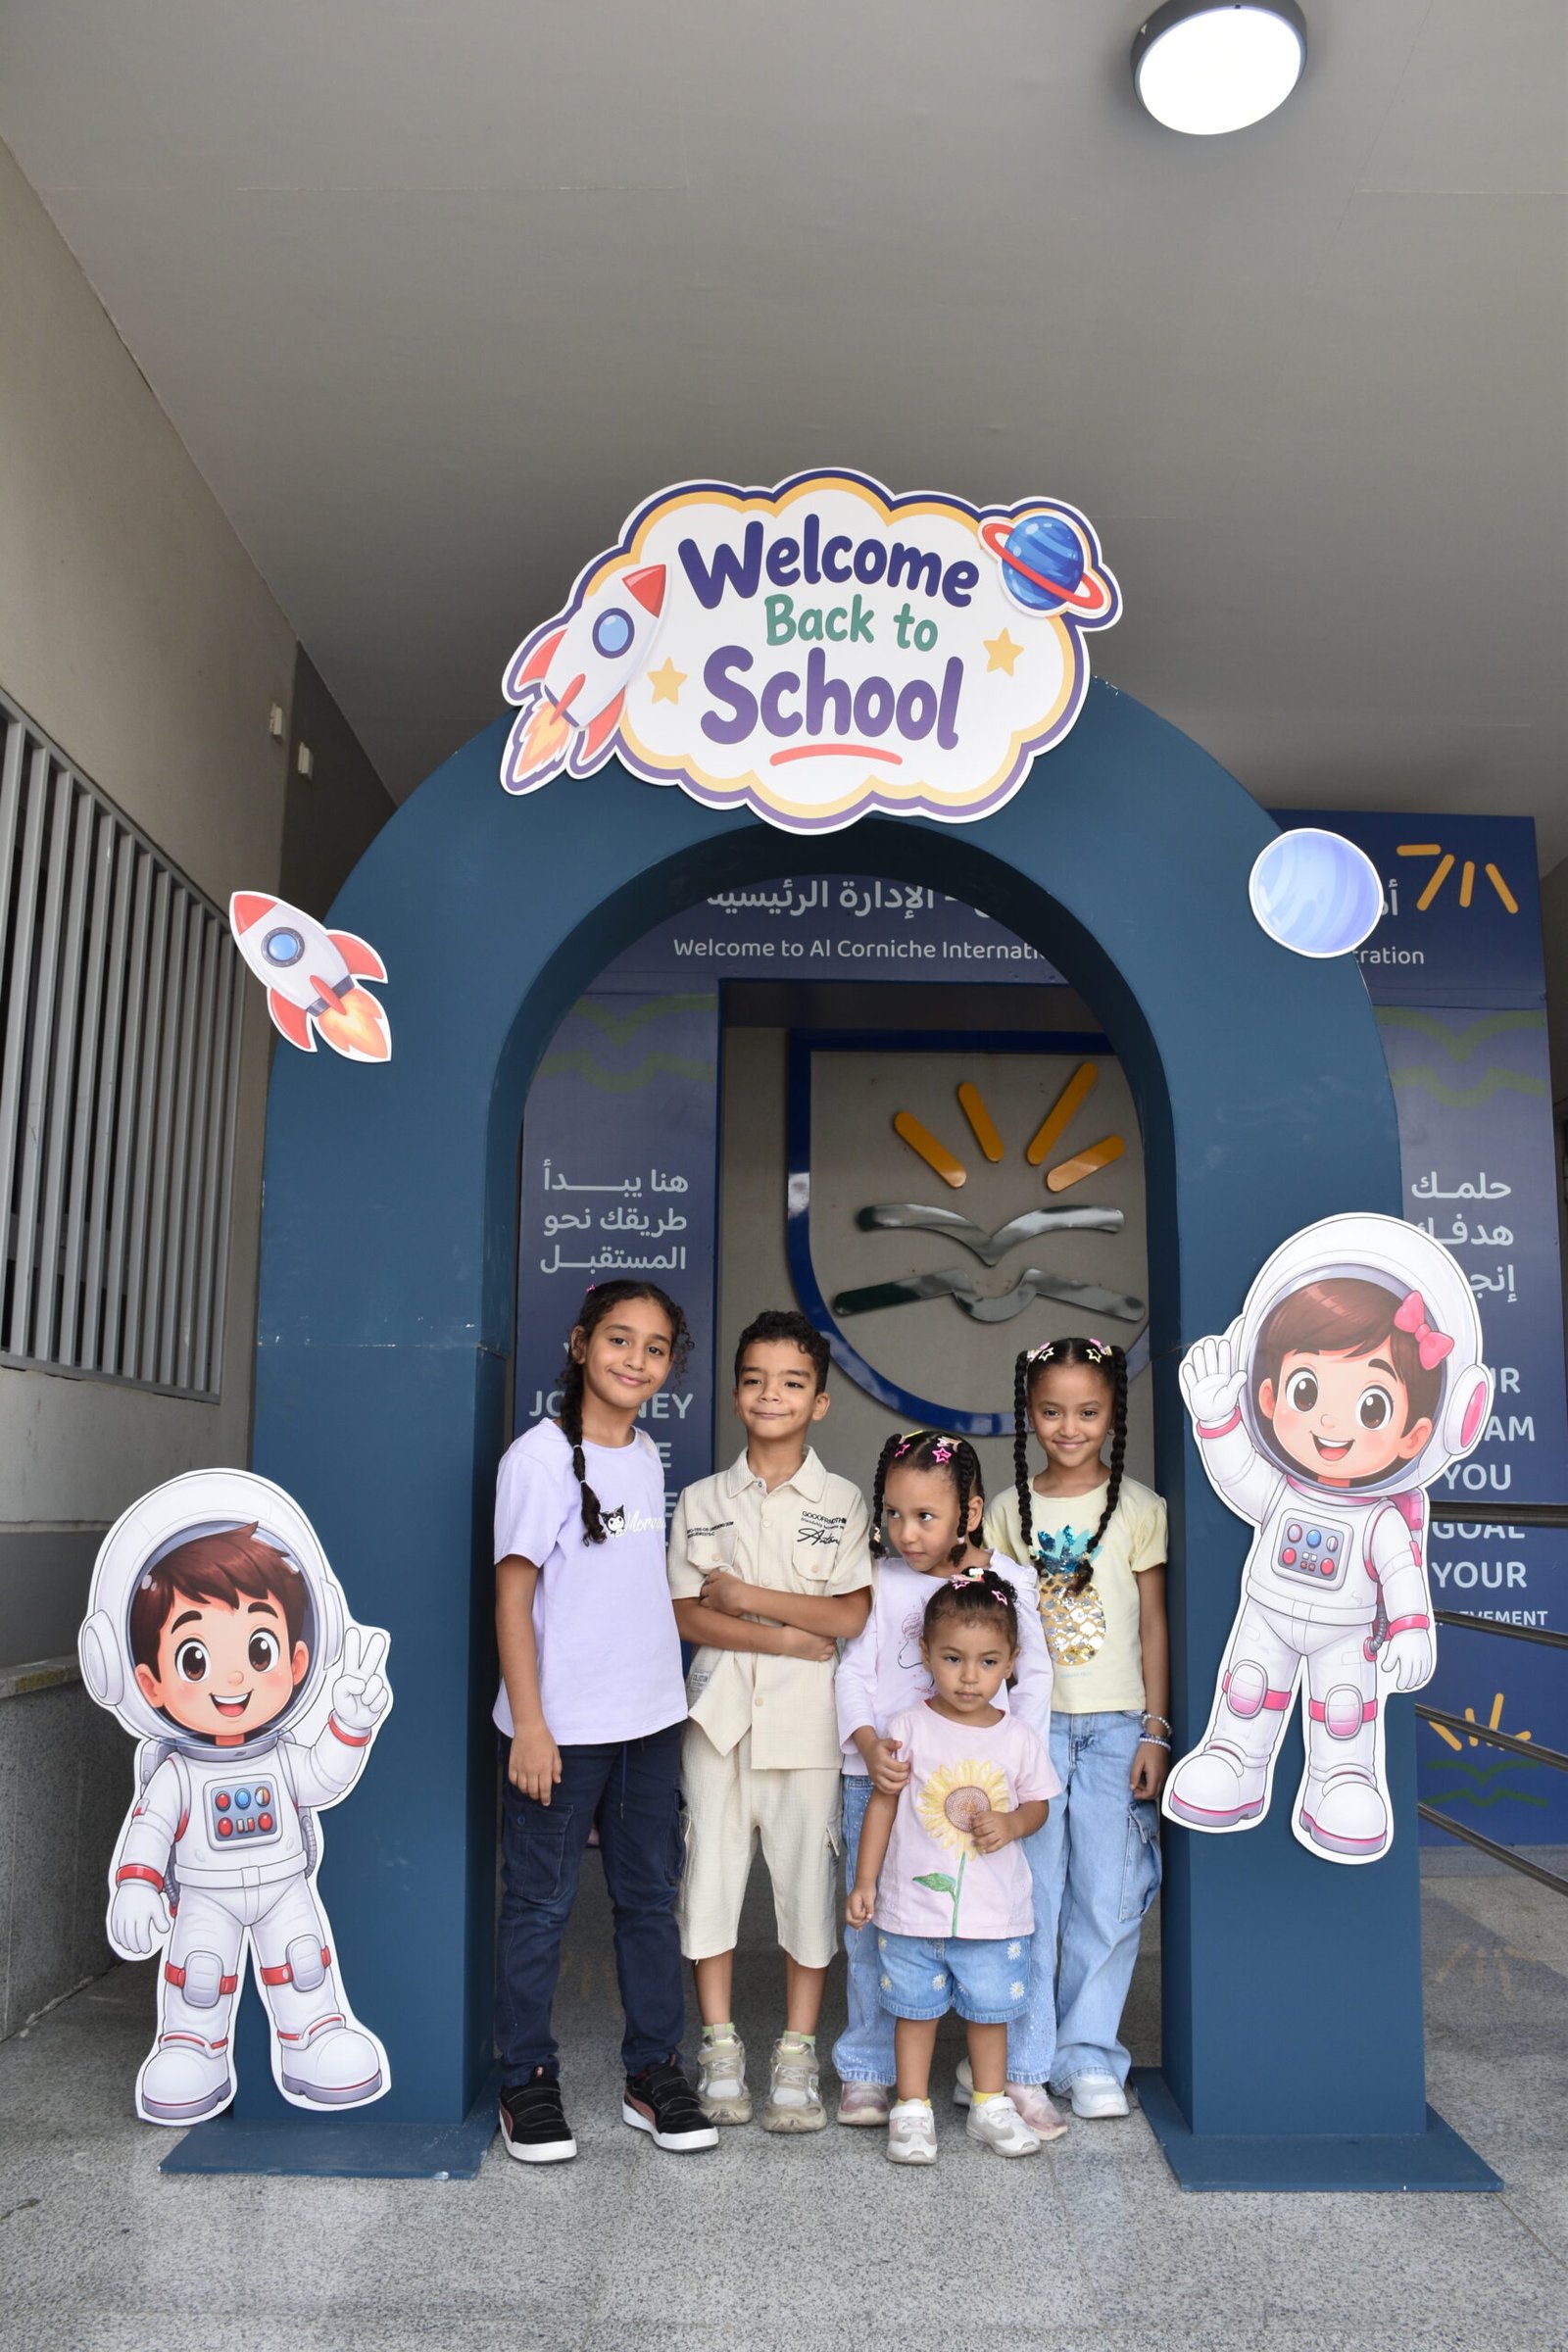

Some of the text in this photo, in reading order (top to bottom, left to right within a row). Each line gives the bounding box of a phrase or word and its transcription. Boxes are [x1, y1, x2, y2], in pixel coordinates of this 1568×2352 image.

[677, 513, 980, 610] Welcome
[764, 594, 939, 653] Back to
[700, 645, 964, 752] School
[673, 938, 776, 957] Welcome
[780, 939, 805, 957] to
[837, 939, 937, 959] Corniche
[942, 941, 1046, 960] Internati
[651, 1169, 689, 1193] هنا
[543, 1206, 688, 1238] طريقك نحو
[1444, 1464, 1511, 1491] YOU
[1431, 1561, 1528, 1589] YOUR
